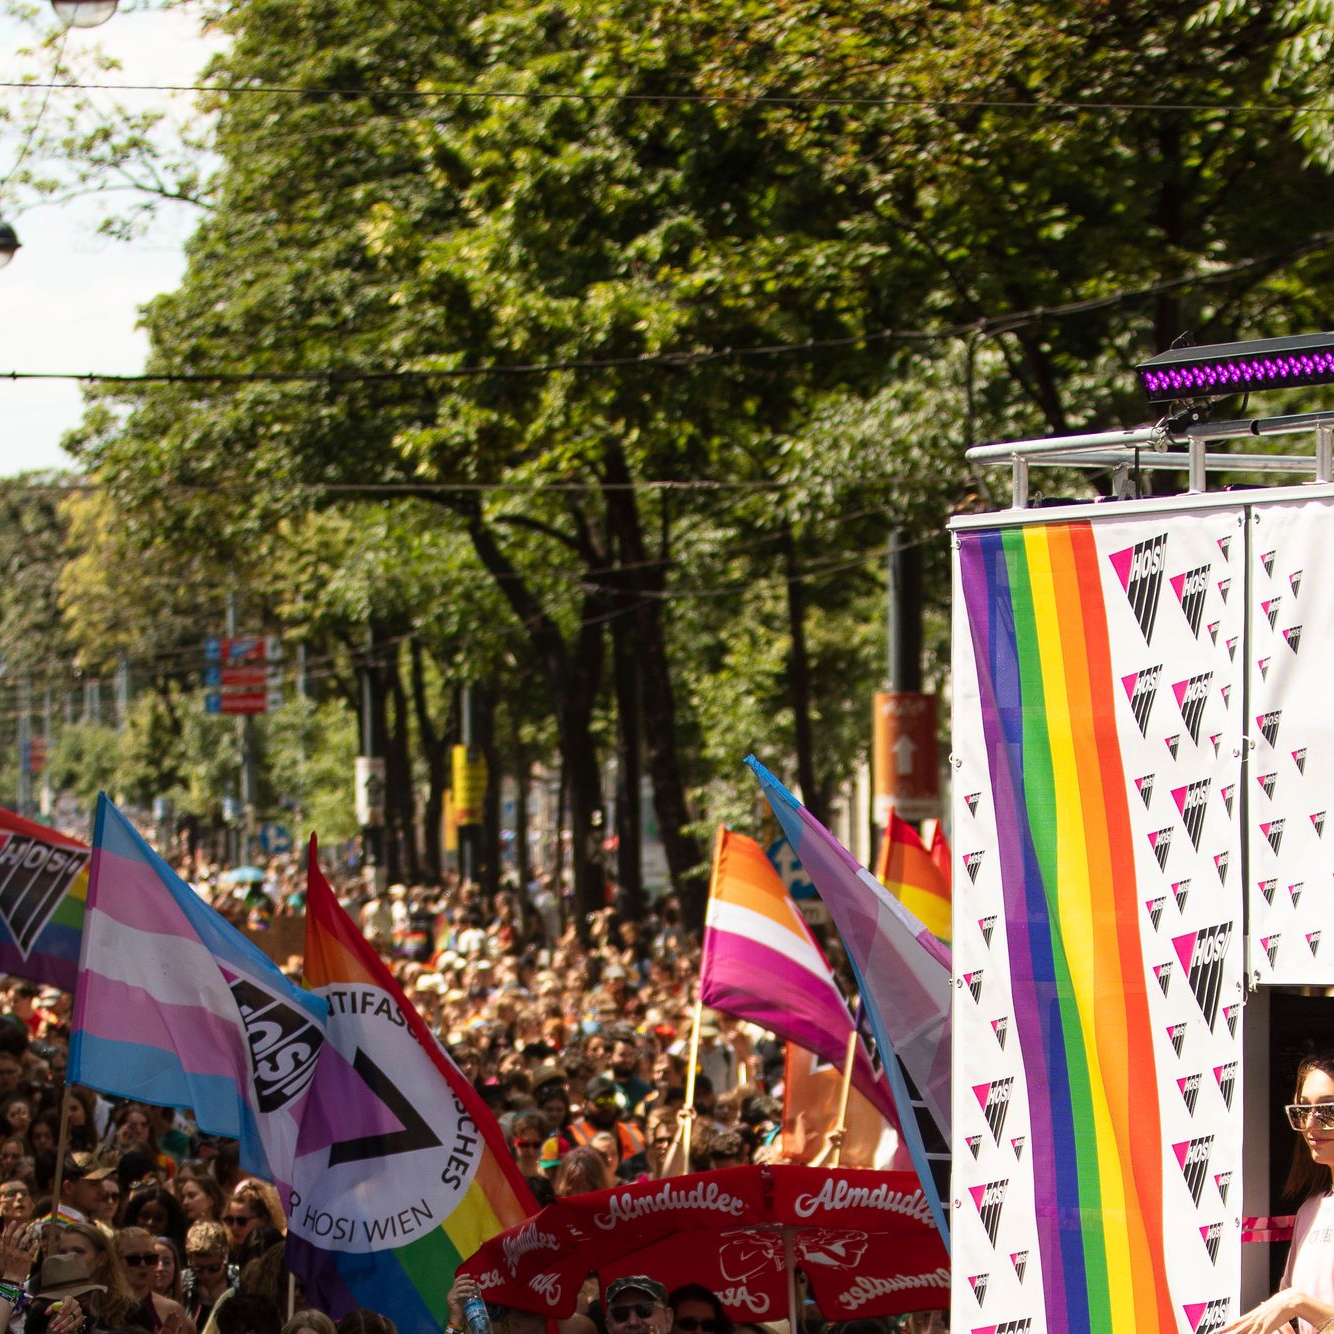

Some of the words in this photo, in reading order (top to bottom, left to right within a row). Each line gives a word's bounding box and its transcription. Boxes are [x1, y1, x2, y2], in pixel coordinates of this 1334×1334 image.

[1131, 543, 1165, 580] HOSI
[1184, 570, 1210, 596] HOSI
[1135, 668, 1162, 696] HOSI
[1186, 676, 1212, 703] HOSI
[1265, 712, 1281, 726] HOSI
[1185, 782, 1210, 810] HOSI
[1192, 932, 1231, 967] HOSI
[986, 1081, 1013, 1106] HOSI
[1186, 1139, 1213, 1166] HOSI
[594, 1182, 745, 1232] Almdudler
[982, 1183, 1008, 1209] HOSI
[302, 1205, 356, 1243] HOSI
[363, 1199, 435, 1243] WIEN
[1199, 1302, 1229, 1327] HOSI
